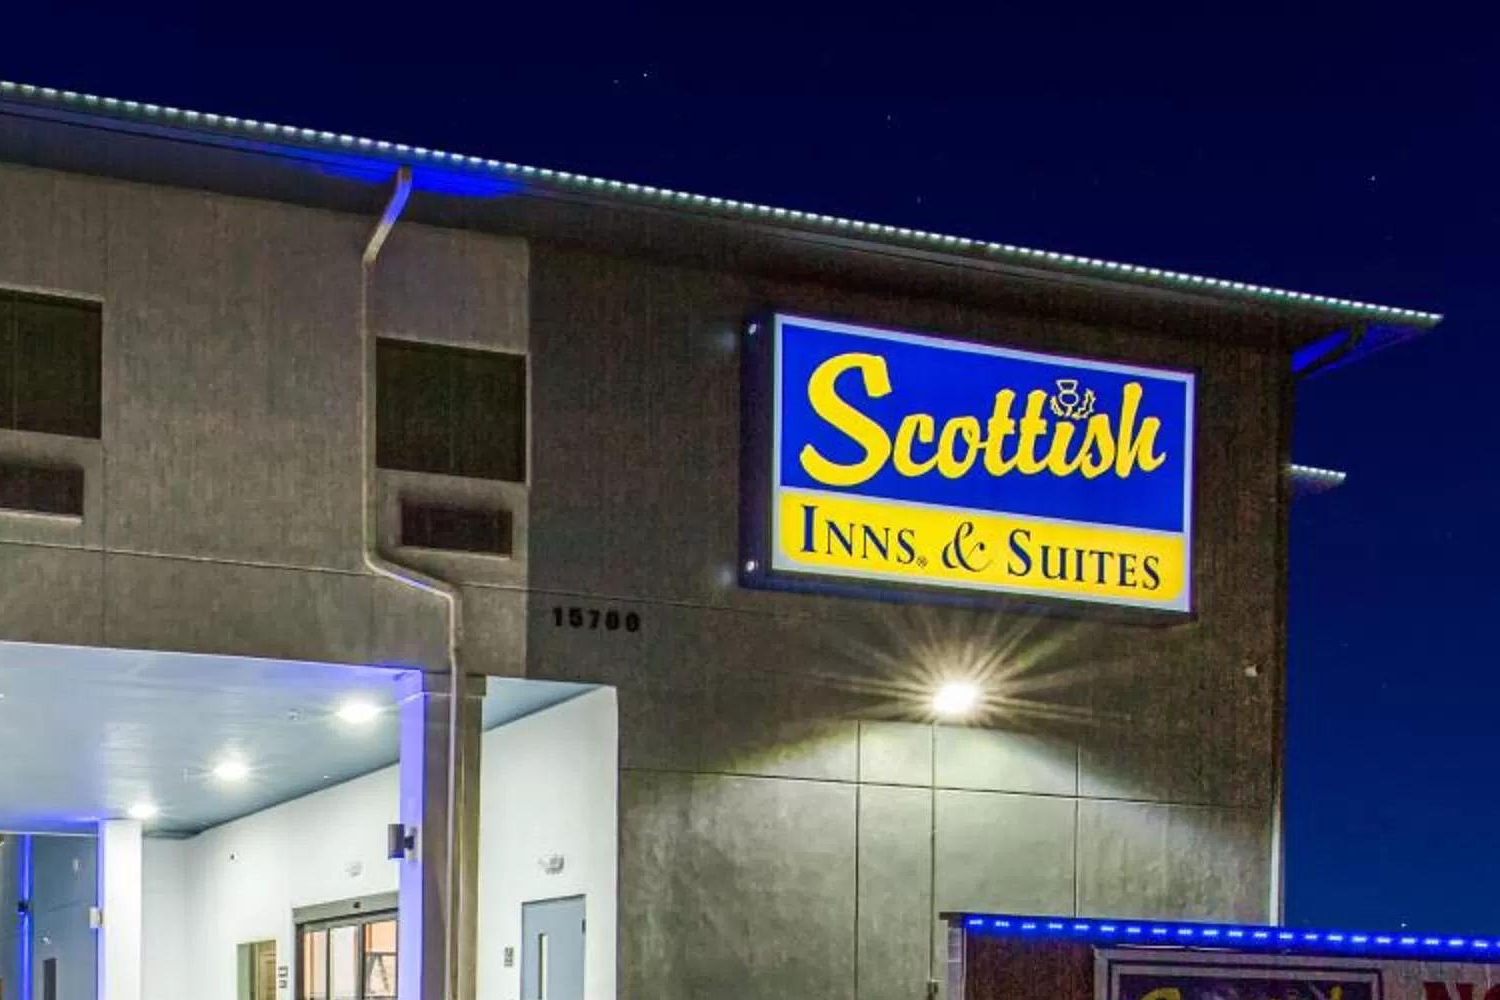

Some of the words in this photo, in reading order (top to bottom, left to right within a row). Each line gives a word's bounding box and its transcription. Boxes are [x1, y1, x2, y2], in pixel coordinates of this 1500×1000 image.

[799, 352, 1166, 487] Scottish
[941, 521, 994, 572] &
[1007, 529, 1161, 591] SUITES
[552, 605, 640, 632] 15700
